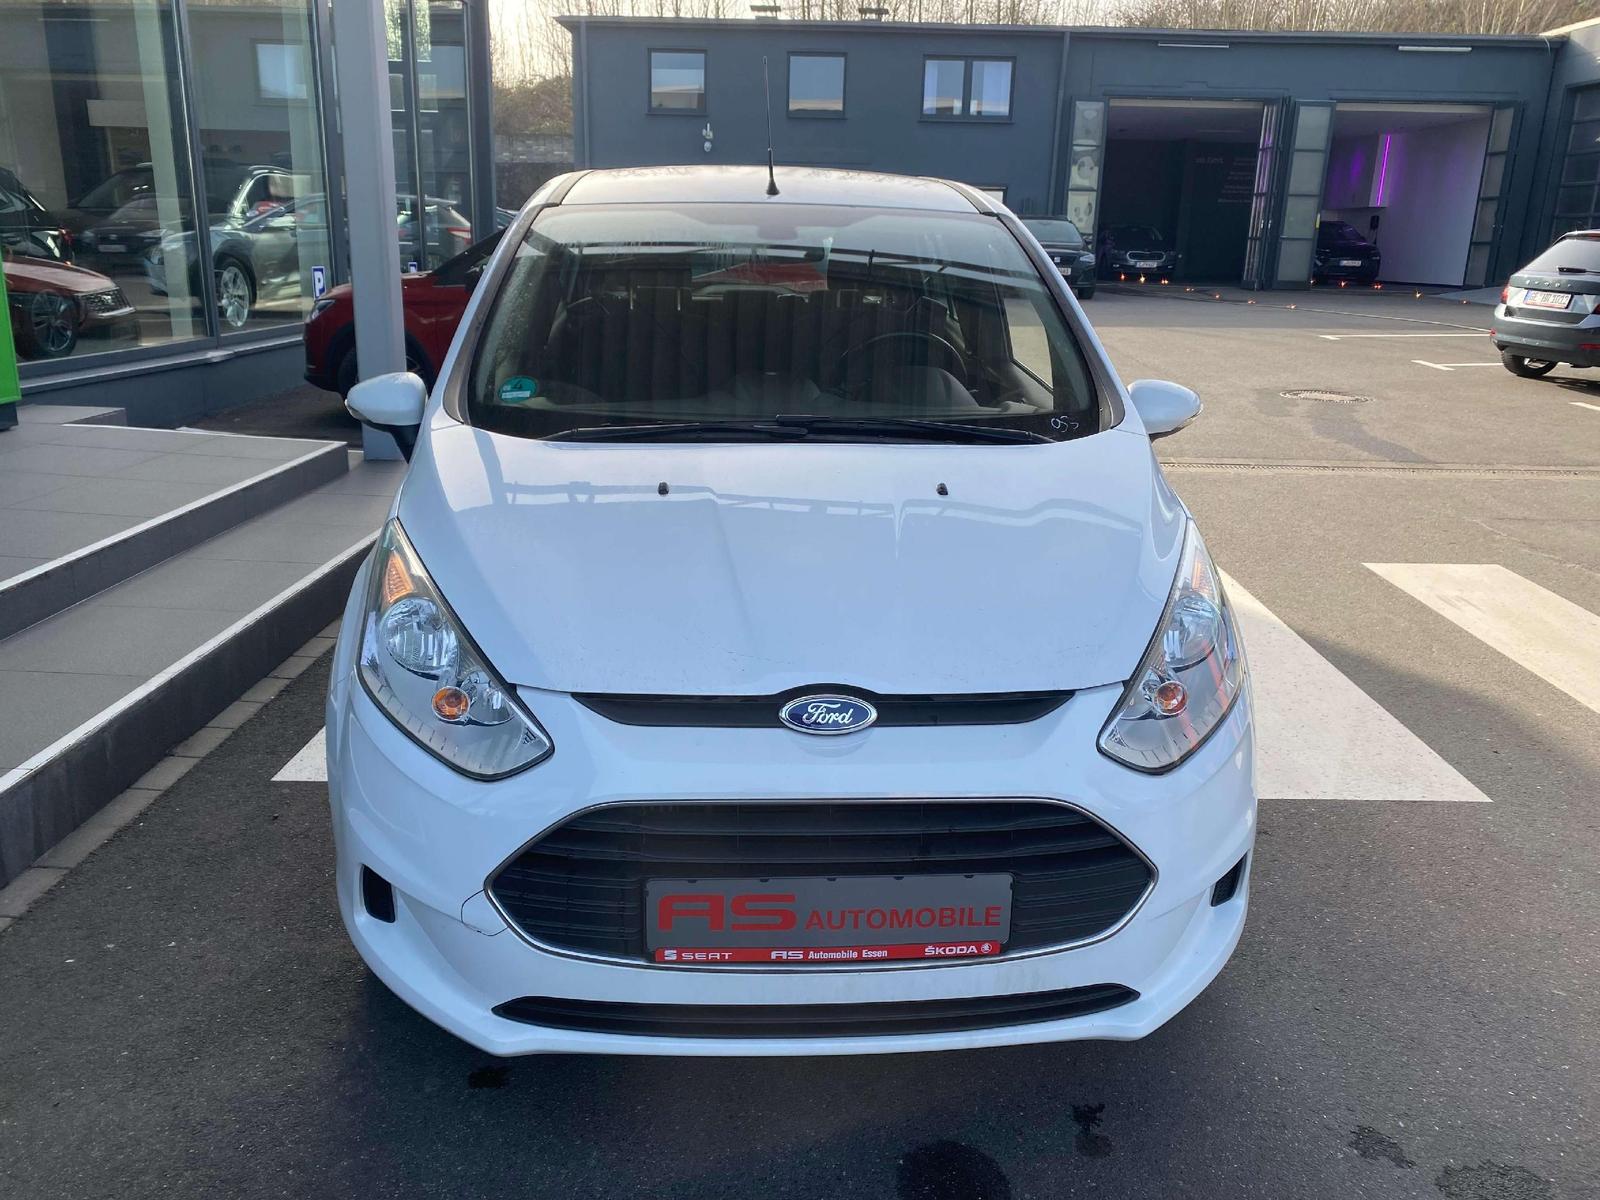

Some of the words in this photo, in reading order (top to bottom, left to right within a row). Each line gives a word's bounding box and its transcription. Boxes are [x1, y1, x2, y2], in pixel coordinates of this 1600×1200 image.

[314, 270, 324, 297] P
[802, 702, 854, 724] Ford
[658, 893, 797, 931] AS
[804, 905, 1003, 932] AUTOMOBILE
[682, 952, 733, 960] SEAT
[771, 950, 804, 960] AS
[808, 949, 858, 960] Automobile
[862, 948, 888, 959] Essen
[924, 945, 978, 956] ŠKODA
